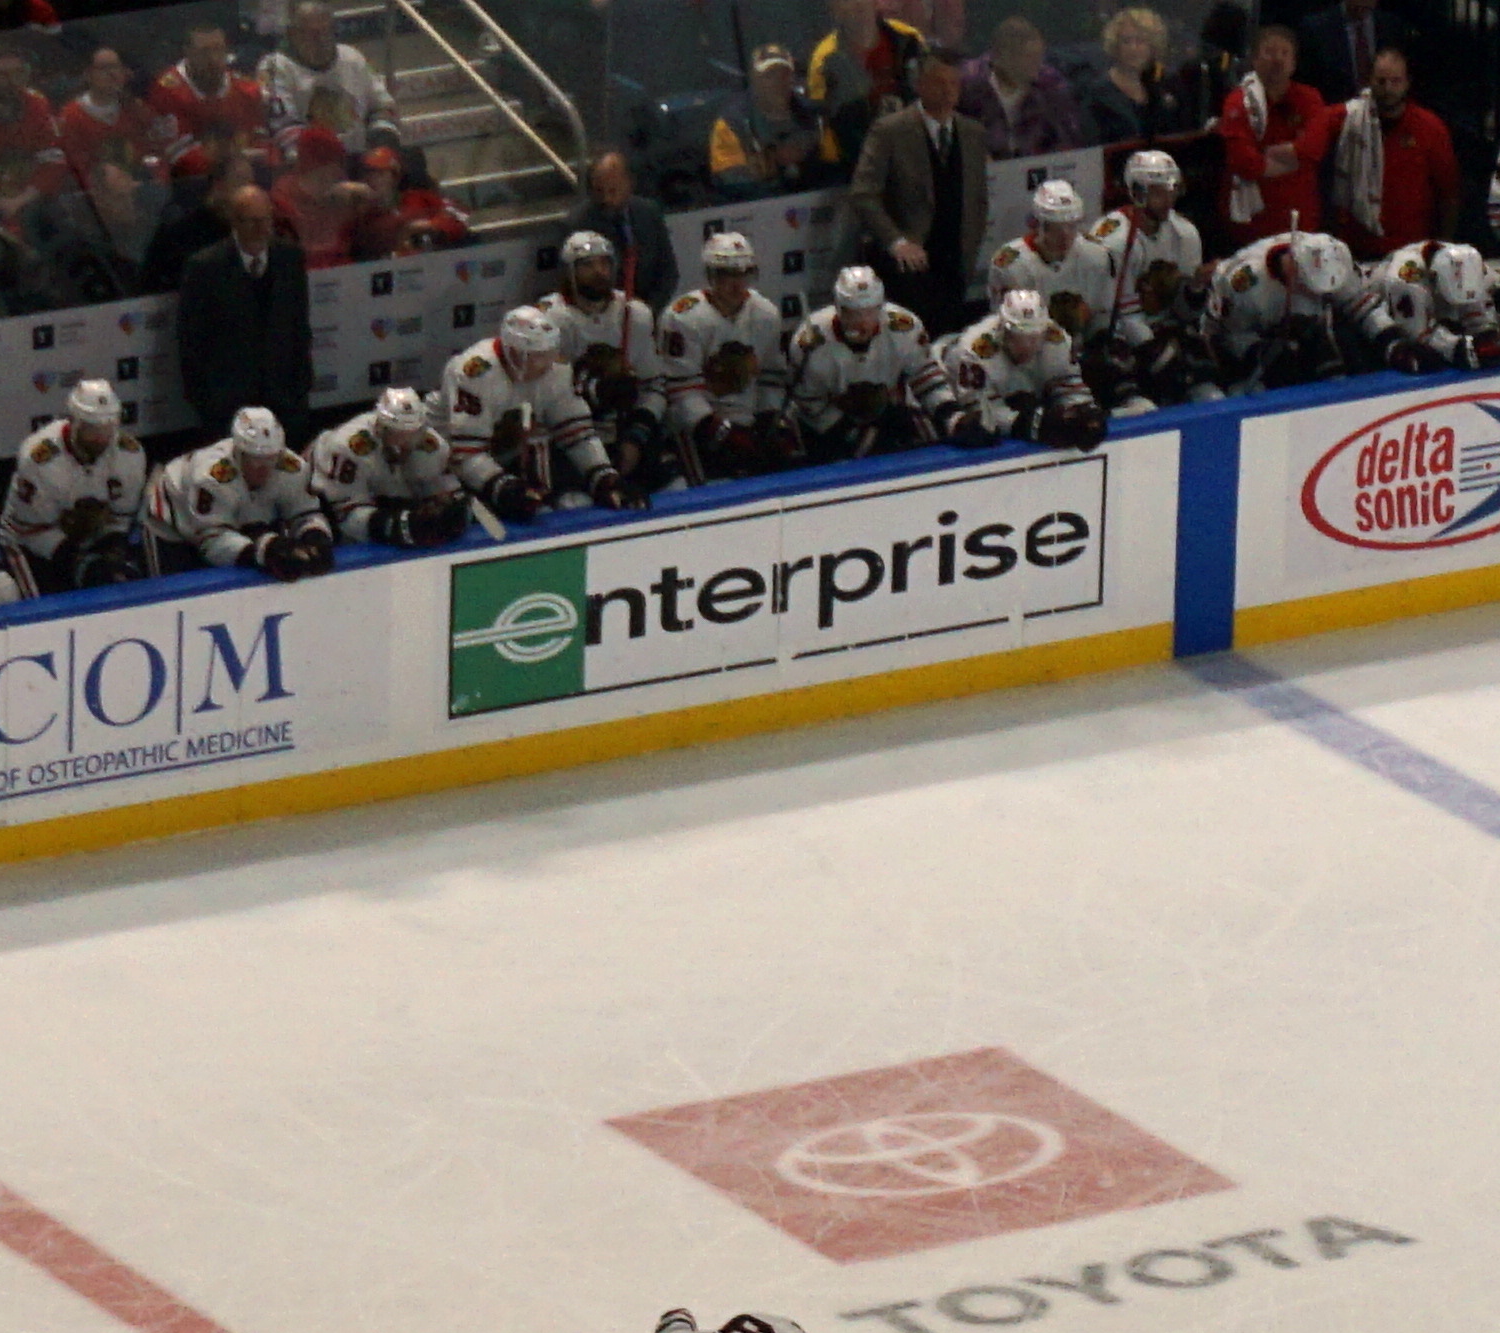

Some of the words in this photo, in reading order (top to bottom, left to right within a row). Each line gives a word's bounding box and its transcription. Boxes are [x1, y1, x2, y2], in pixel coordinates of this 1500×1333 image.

[1355, 421, 1455, 488] delta
[1355, 476, 1455, 532] sonic
[453, 509, 1090, 664] enterprise
[28, 740, 180, 786] OSTEOPATHIC
[185, 721, 294, 760] MEDICINE
